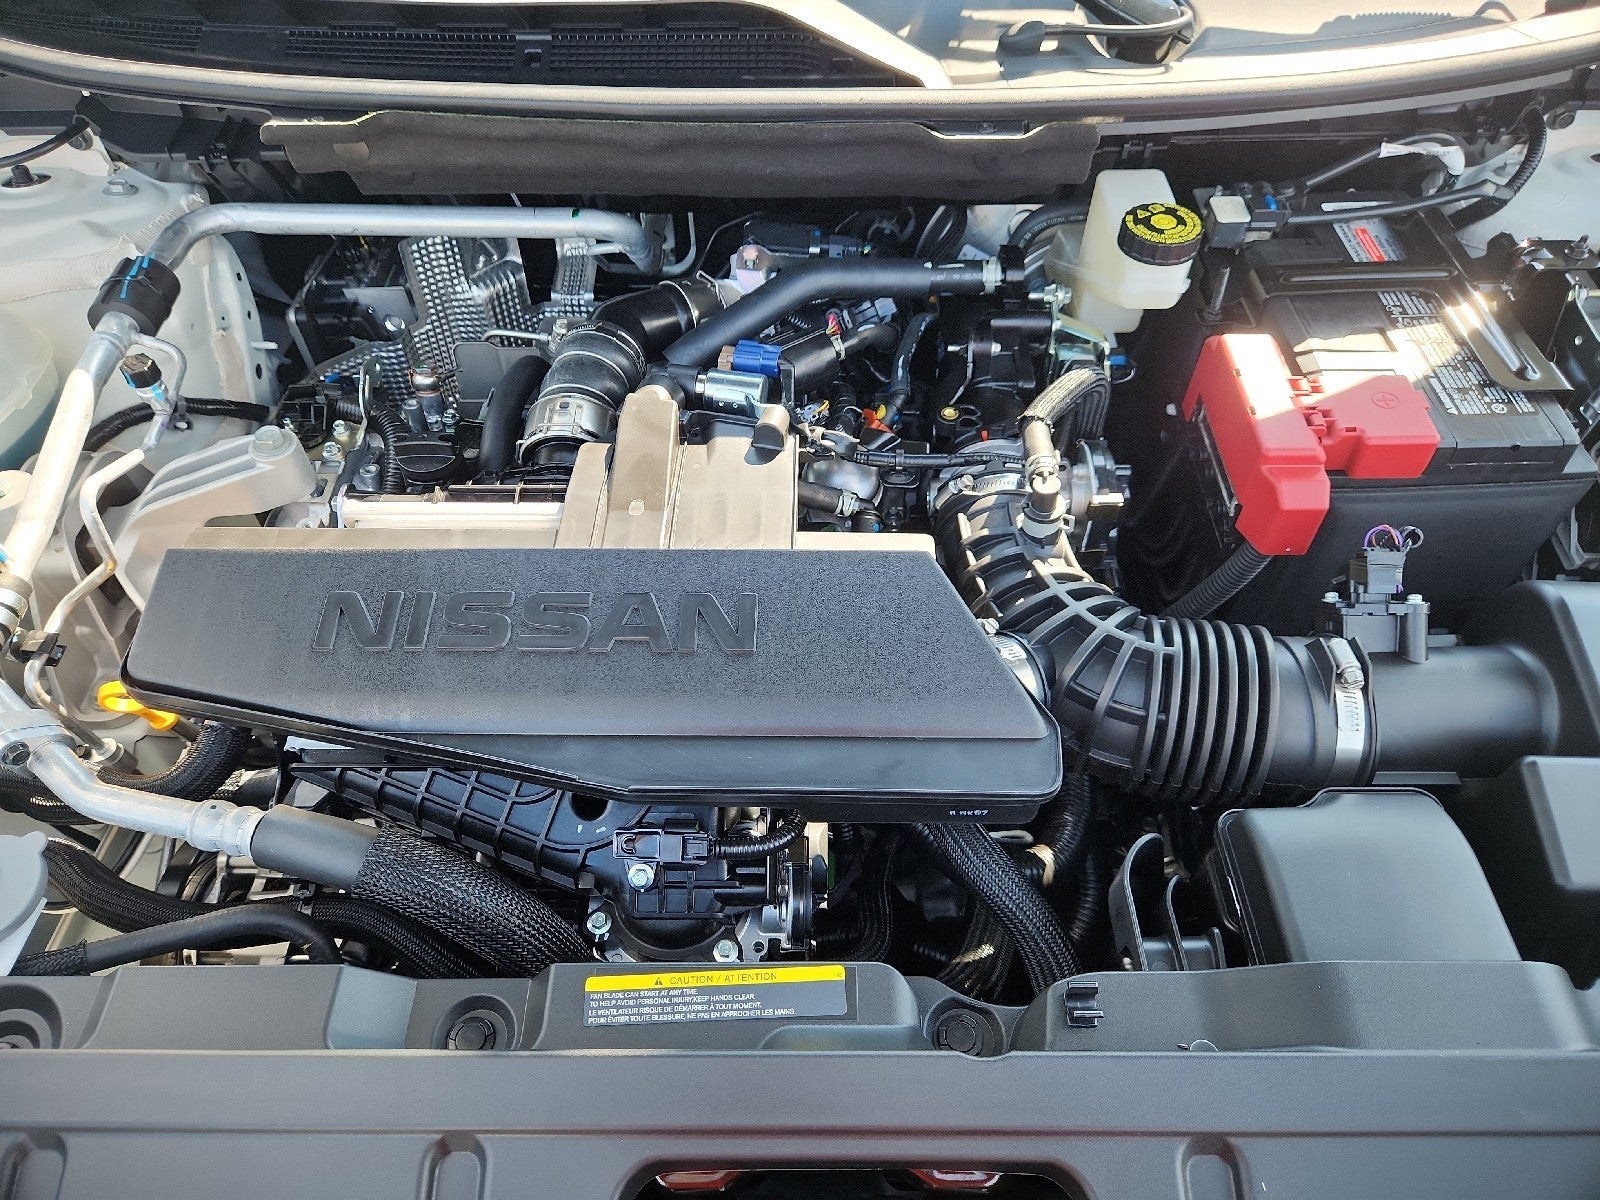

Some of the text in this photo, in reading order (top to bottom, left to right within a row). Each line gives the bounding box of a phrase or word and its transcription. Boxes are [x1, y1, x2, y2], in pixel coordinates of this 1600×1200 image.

[312, 590, 758, 653] NISSAN
[669, 975, 713, 985] CAUTION
[724, 972, 777, 983] ATTENTION
[603, 991, 625, 999] BLADE
[637, 997, 672, 1005] PERSONAL
[710, 994, 733, 1002] HANDS
[588, 1009, 597, 1017] LE
[597, 1007, 639, 1016] VENTILATEUR
[639, 1006, 664, 1014] RISQUE
[663, 1005, 674, 1013] DE
[674, 1003, 708, 1012] DÉMARRER
[732, 1001, 763, 1009] MOMENT.
[587, 1017, 607, 1025] POUR
[607, 1015, 630, 1023] ÉVITER
[686, 1012, 697, 1020] NE
[720, 1009, 761, 1018] APPROCHER
